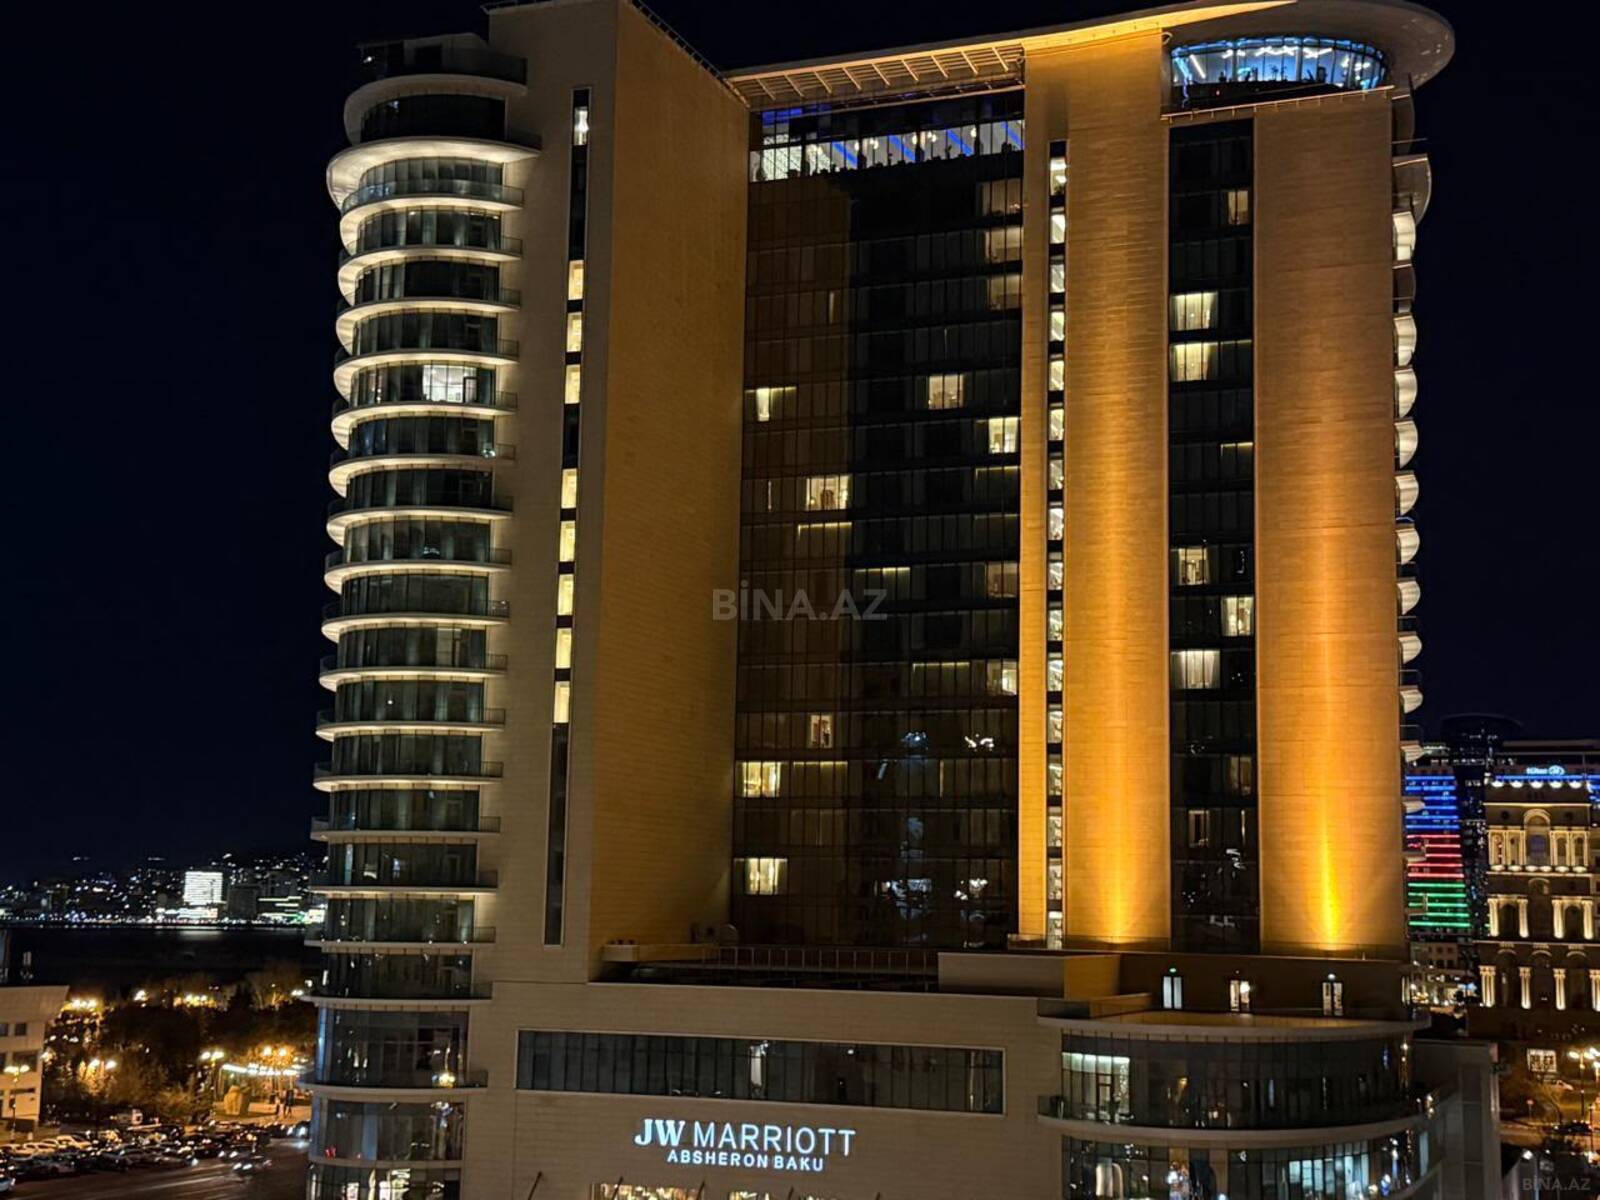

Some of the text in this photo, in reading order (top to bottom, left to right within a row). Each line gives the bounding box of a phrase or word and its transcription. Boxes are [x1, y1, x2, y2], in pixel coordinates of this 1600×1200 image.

[634, 1118, 856, 1157] JW MARRIOTT
[667, 1149, 824, 1172] ABSHERON BAKU
